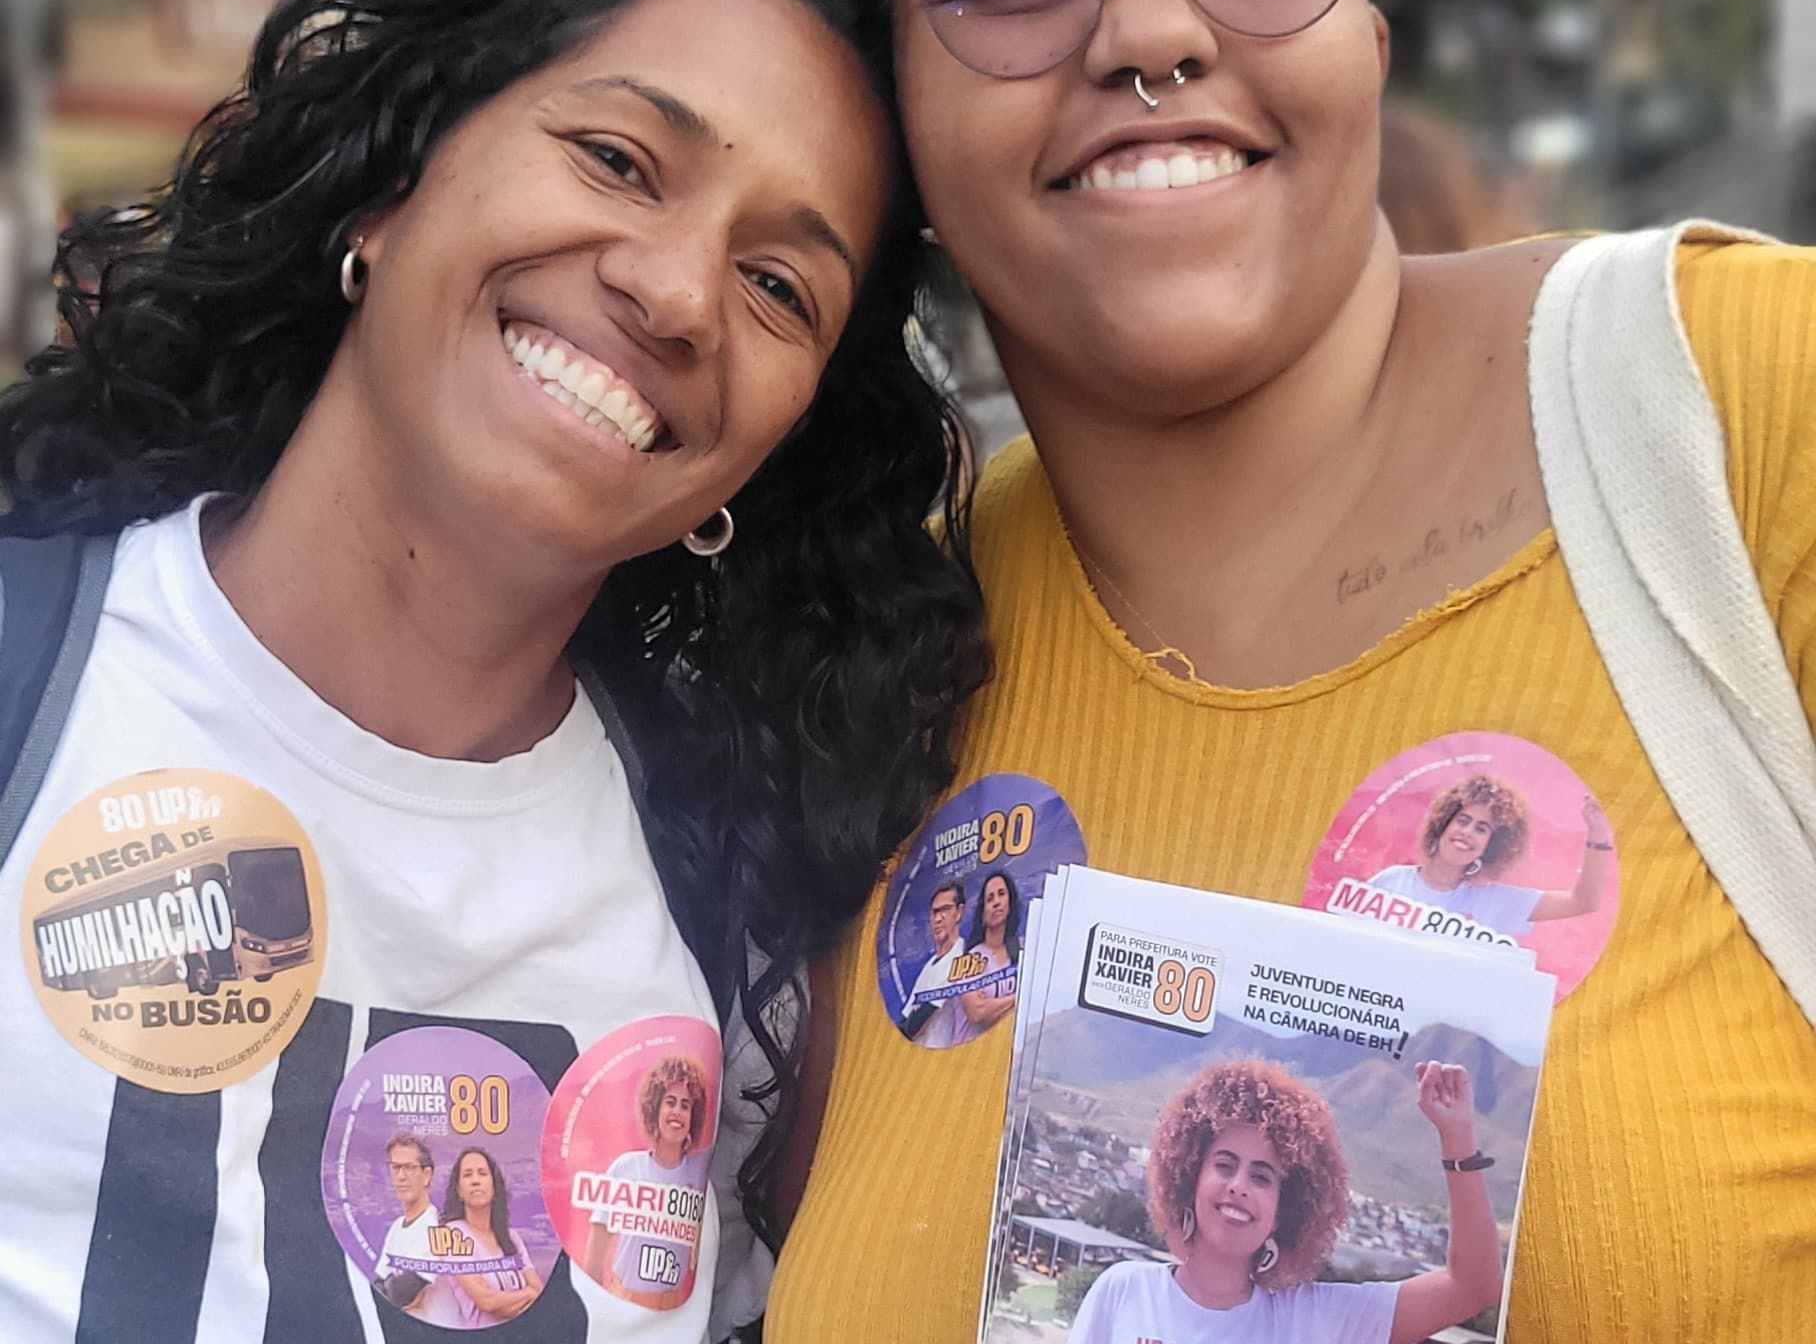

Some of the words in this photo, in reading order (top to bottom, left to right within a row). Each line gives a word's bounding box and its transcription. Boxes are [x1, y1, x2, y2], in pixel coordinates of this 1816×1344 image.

[99, 793, 145, 833] 80
[935, 818, 980, 850] INDIRA
[980, 803, 1035, 864] 80
[44, 832, 177, 894] CHEGA
[181, 825, 214, 849] DE
[935, 836, 979, 868] XAVIER
[38, 867, 235, 981] HUMILHAÇÃO
[1334, 884, 1424, 929] MARI
[1098, 944, 1155, 972] INDIRA
[1101, 931, 1127, 946] PARA
[1129, 937, 1188, 959] PREFEITURA
[1191, 953, 1217, 967] VOTE
[1095, 962, 1153, 989] XAVIER
[1104, 981, 1150, 1000] GERALDO
[1153, 959, 1216, 1023] 80
[1250, 964, 1346, 997] JUVENTUDE
[1348, 986, 1405, 1011] NEGRA
[92, 1002, 134, 1022] NO
[141, 989, 272, 1028] BUSÃO
[1118, 994, 1150, 1010] NERES
[1247, 984, 1259, 998] E
[1259, 987, 1401, 1032] REVOLUCIONÁRIA
[1244, 1004, 1266, 1022] NA
[1269, 1010, 1340, 1040] CÂMARA
[1343, 1029, 1366, 1046] DE
[383, 1074, 447, 1094] INDIRA
[383, 1093, 447, 1113] XAVIER
[449, 1074, 511, 1135] 80
[577, 1176, 666, 1212] MARI
[609, 1210, 697, 1244] FERNANDES
[394, 1256, 429, 1271] PODER
[429, 1258, 475, 1273] POPULAR
[475, 1258, 501, 1272] PARA
